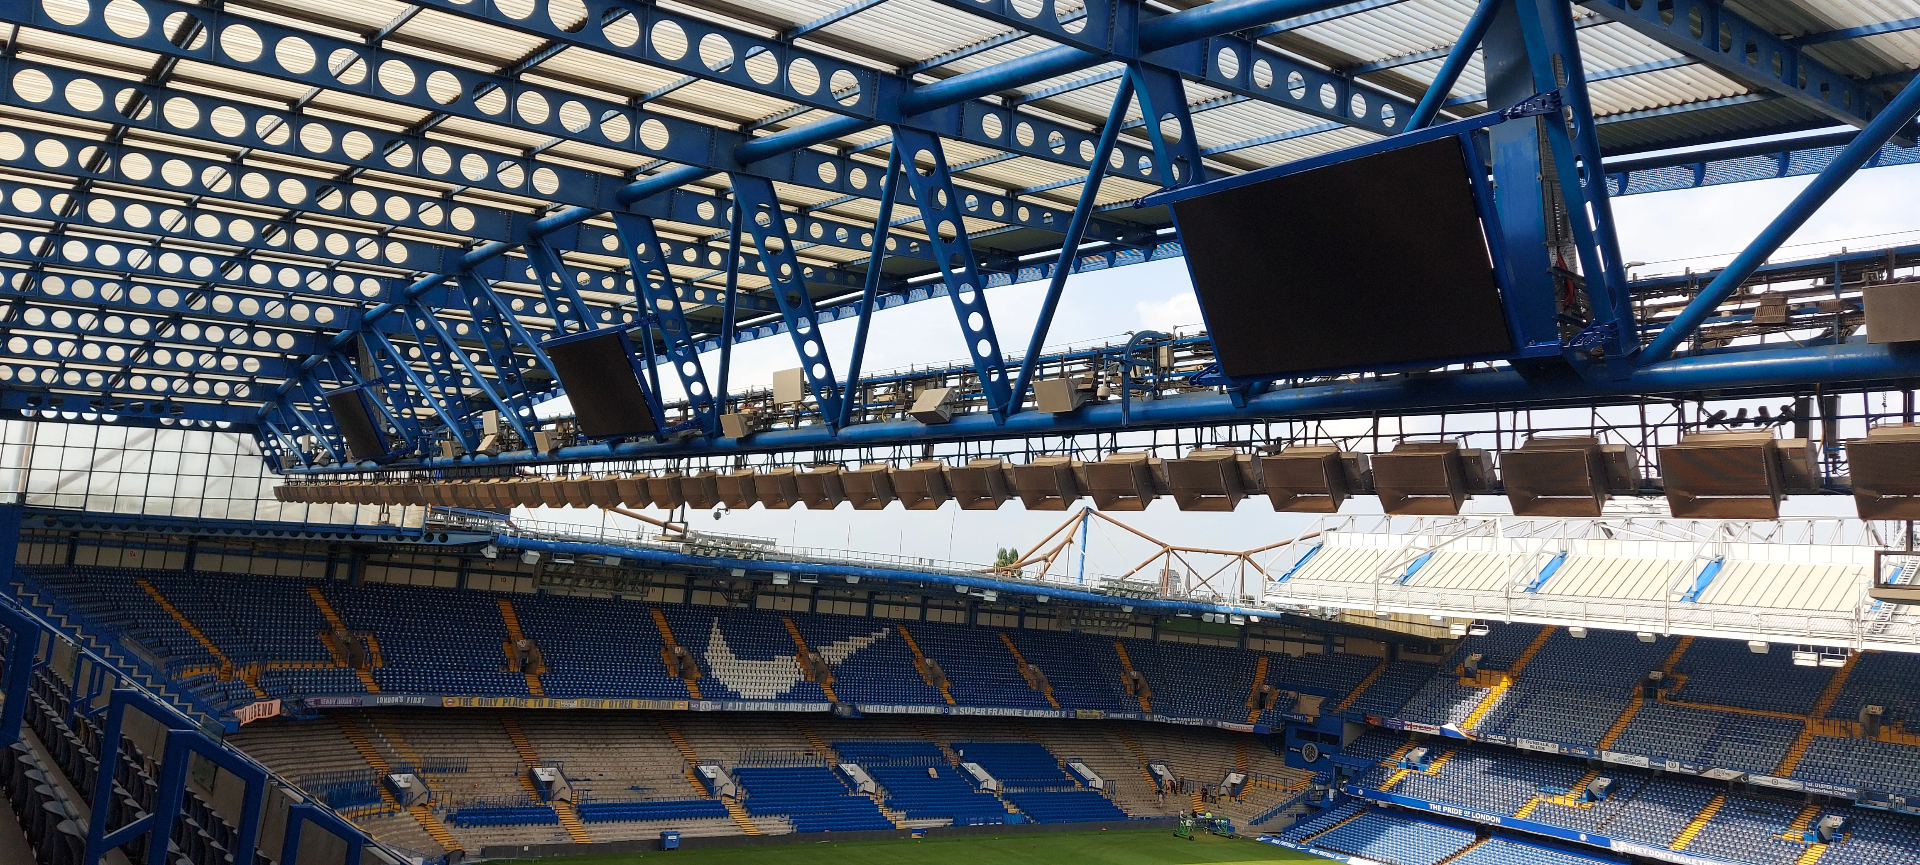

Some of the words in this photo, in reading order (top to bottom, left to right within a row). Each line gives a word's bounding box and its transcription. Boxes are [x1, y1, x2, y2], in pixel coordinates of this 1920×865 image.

[376, 696, 406, 704] LONDON'S
[458, 697, 473, 706] THE
[478, 697, 499, 707] ONLY
[502, 698, 528, 707] PLACE
[533, 699, 544, 707] TO
[548, 699, 559, 708] BE
[580, 699, 605, 708] EVERY
[608, 700, 634, 708] OTHER
[637, 701, 675, 709] SATURDAY
[248, 702, 274, 719] LEGEND
[865, 704, 892, 713] CHELSEA
[907, 705, 935, 714] RELIGION
[959, 707, 986, 715] SUPER
[987, 708, 1022, 716] FRANKIE
[1023, 709, 1060, 718] LAMPARD
[1834, 786, 1858, 794] CHELSEA
[1429, 803, 1442, 812] THE
[1443, 805, 1463, 816] PRIDE
[1471, 812, 1501, 824] LONDON
[1628, 845, 1648, 855] THEY
[1673, 855, 1697, 865] MAKE
